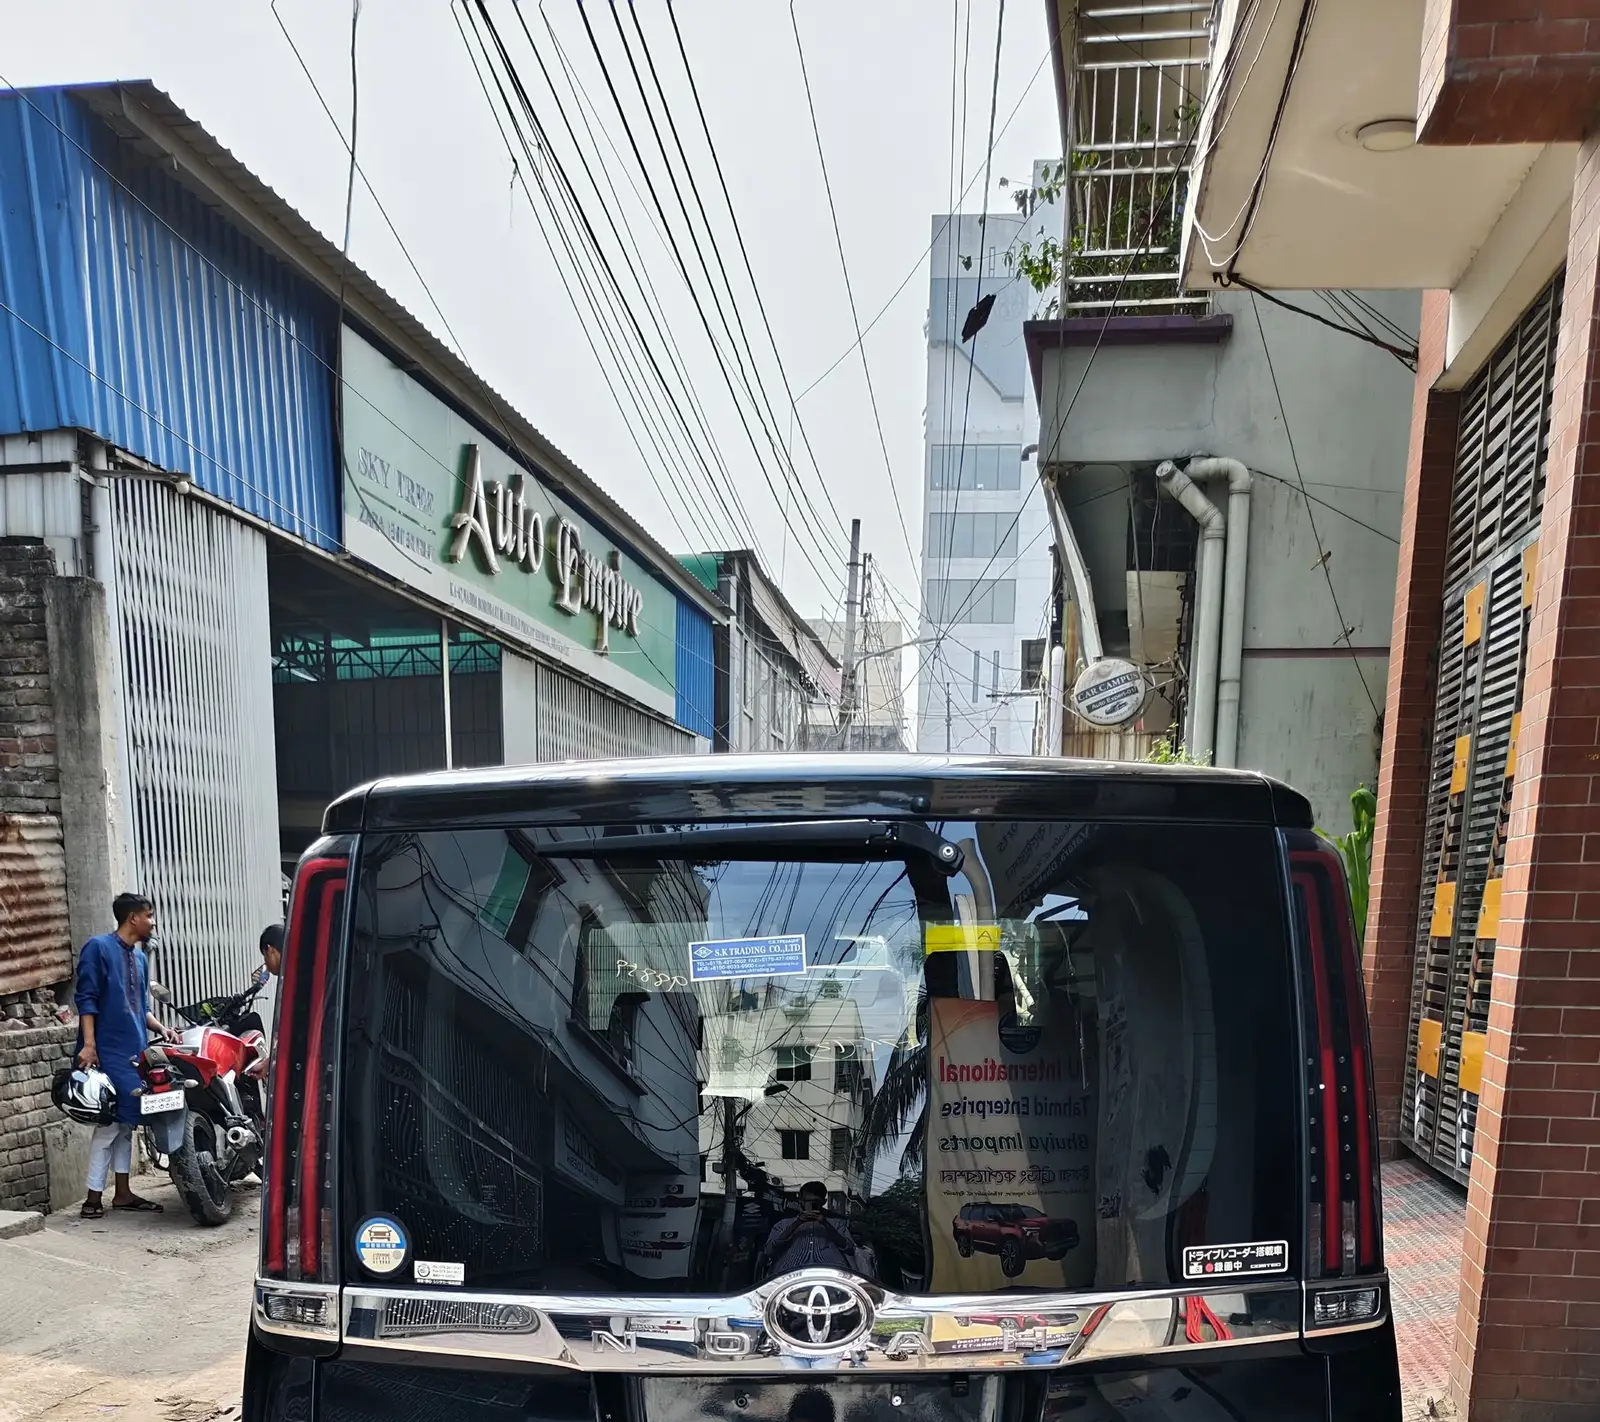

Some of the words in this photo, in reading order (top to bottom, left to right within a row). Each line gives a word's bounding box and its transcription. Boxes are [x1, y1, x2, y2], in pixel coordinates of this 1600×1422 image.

[357, 447, 390, 489] SKY
[450, 443, 545, 575] Auto
[556, 516, 644, 656] Empire
[1077, 687, 1098, 701] CAR
[1098, 672, 1139, 692] CAMPUS
[1091, 699, 1106, 710] Auto
[729, 946, 766, 957] TRADING
